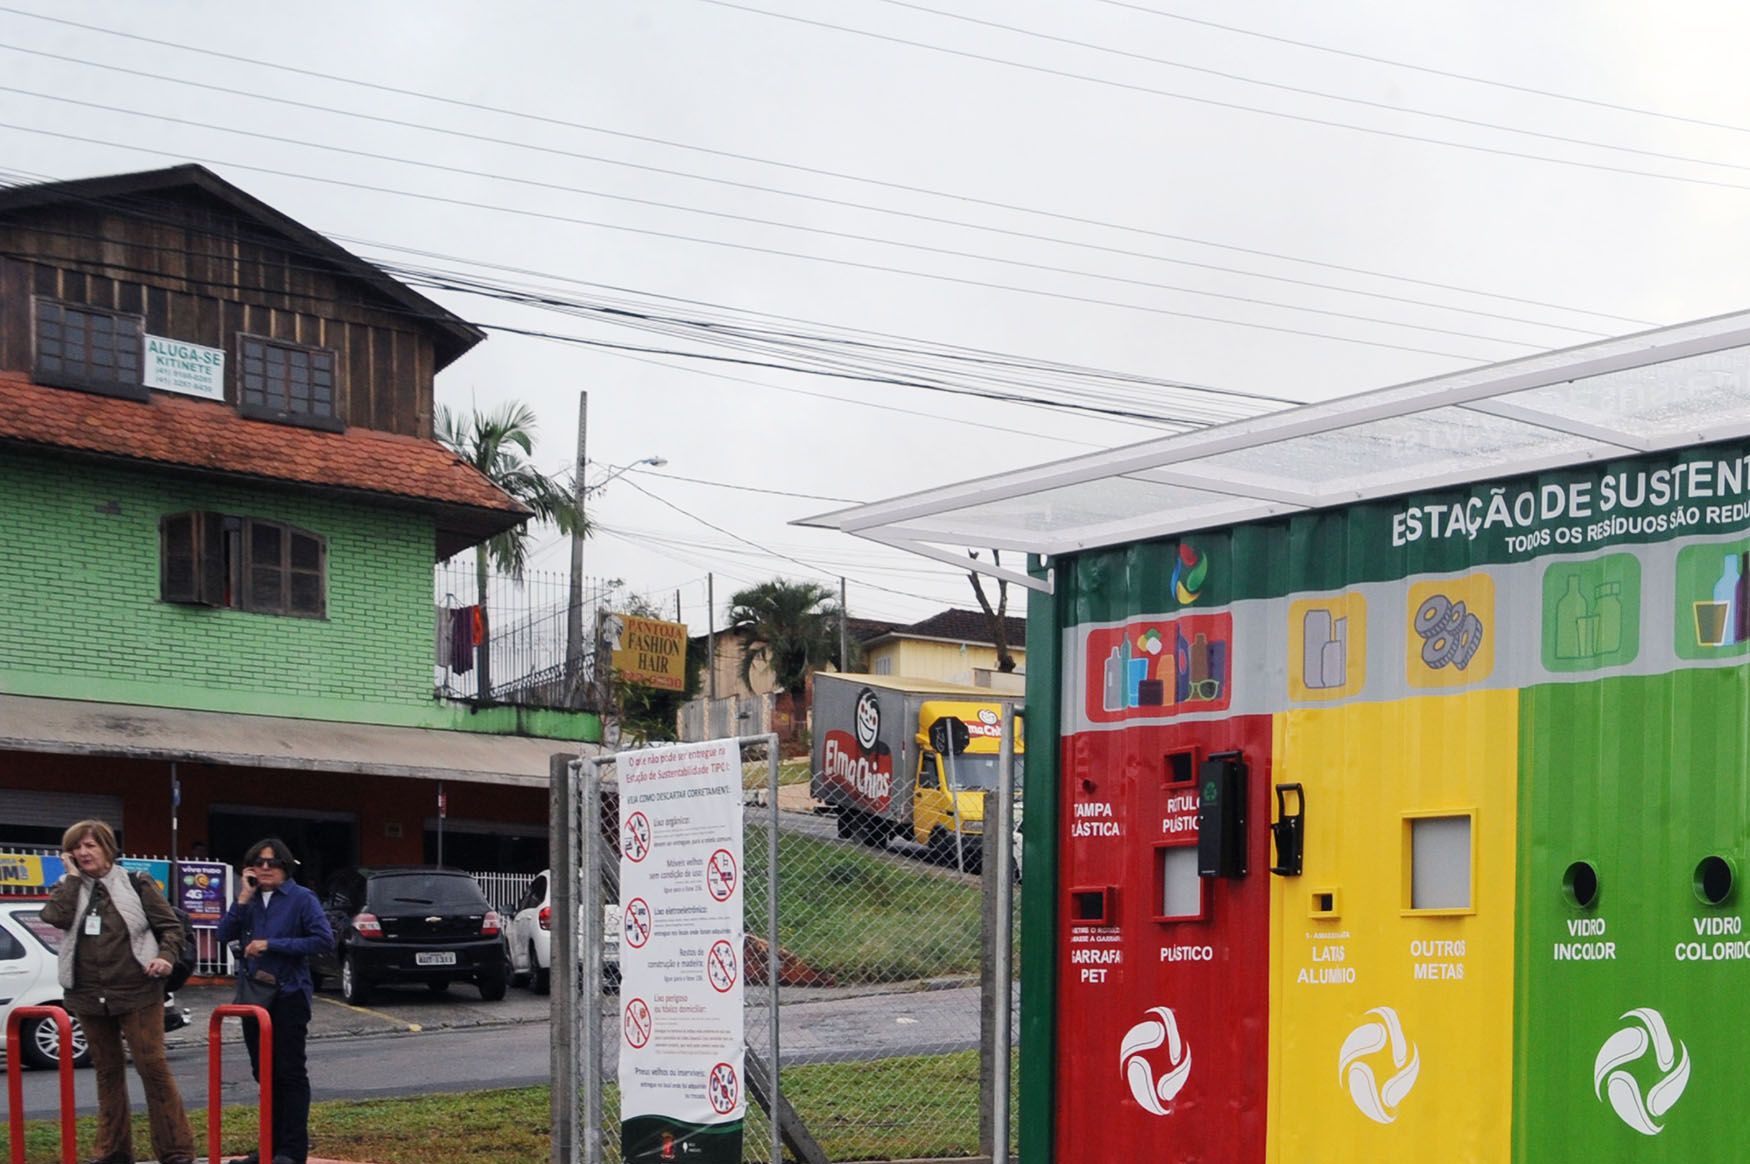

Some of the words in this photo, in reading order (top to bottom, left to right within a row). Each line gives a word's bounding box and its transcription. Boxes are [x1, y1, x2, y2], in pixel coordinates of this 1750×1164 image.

[149, 340, 221, 367] ALUGA-SE
[156, 356, 213, 375] KITINETE
[1392, 487, 1535, 547] ESTAÇÃO
[1541, 481, 1592, 520] DE
[1505, 524, 1550, 553] TODOS
[1555, 526, 1582, 545] OS
[1587, 513, 1667, 541] RESÍDUOS
[1669, 506, 1699, 529] SÃO
[628, 620, 683, 640] PANTOJA
[628, 632, 680, 656] FASHION
[638, 652, 669, 673] HAIR
[1074, 802, 1112, 817] TAMPA
[185, 889, 203, 900] 4G
[1567, 917, 1606, 937] VIDRO
[1693, 916, 1741, 936] VIDRO
[1410, 940, 1466, 957] OUTROS
[1554, 942, 1616, 960] INCOLOR
[1081, 969, 1107, 983] PET
